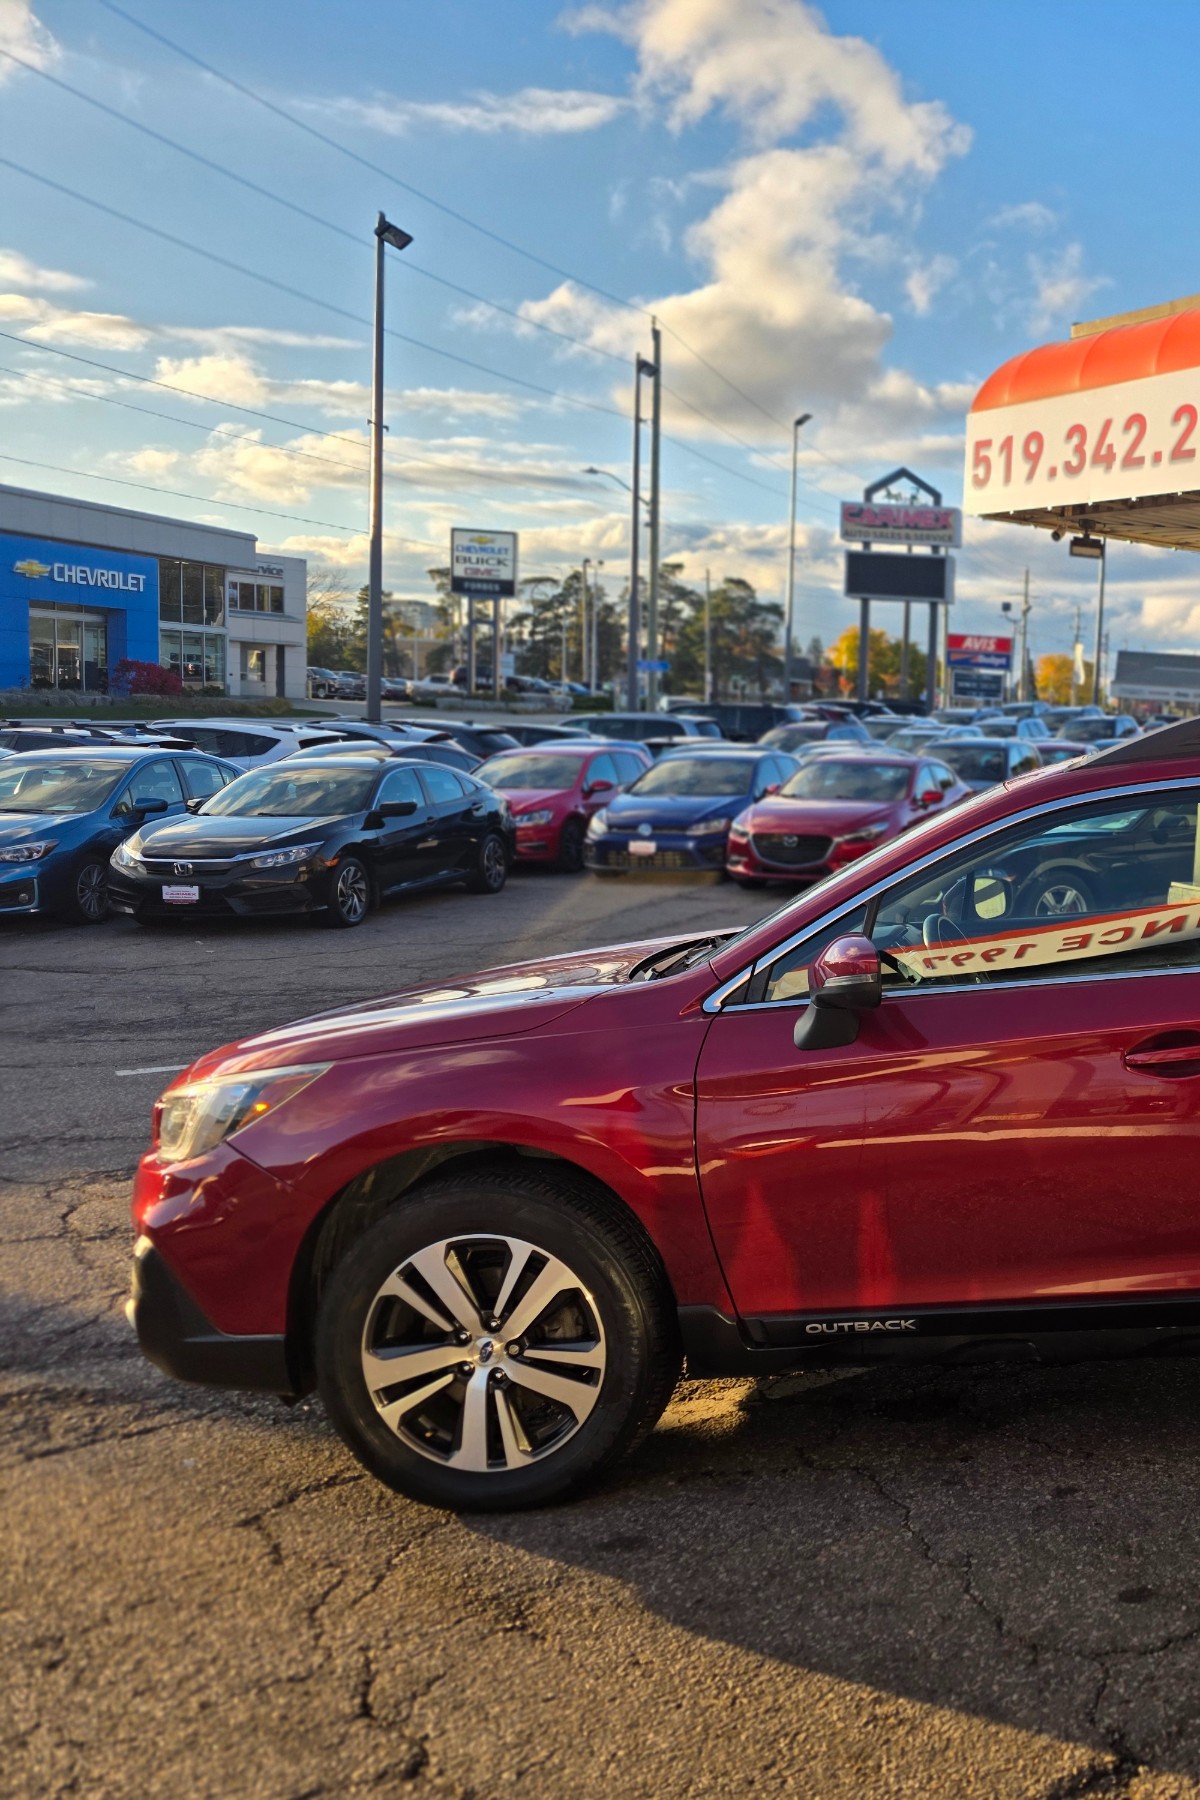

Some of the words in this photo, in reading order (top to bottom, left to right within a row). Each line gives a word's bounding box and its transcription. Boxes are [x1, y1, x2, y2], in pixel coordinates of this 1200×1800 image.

[844, 505, 953, 529] CARIMEX
[455, 544, 509, 555] CHEVROLET
[455, 555, 509, 567] BUICK
[53, 562, 146, 592] CHEVROLET
[464, 567, 501, 577] GMC
[961, 635, 997, 652] AVIS
[805, 1319, 918, 1334] OUTBACK
